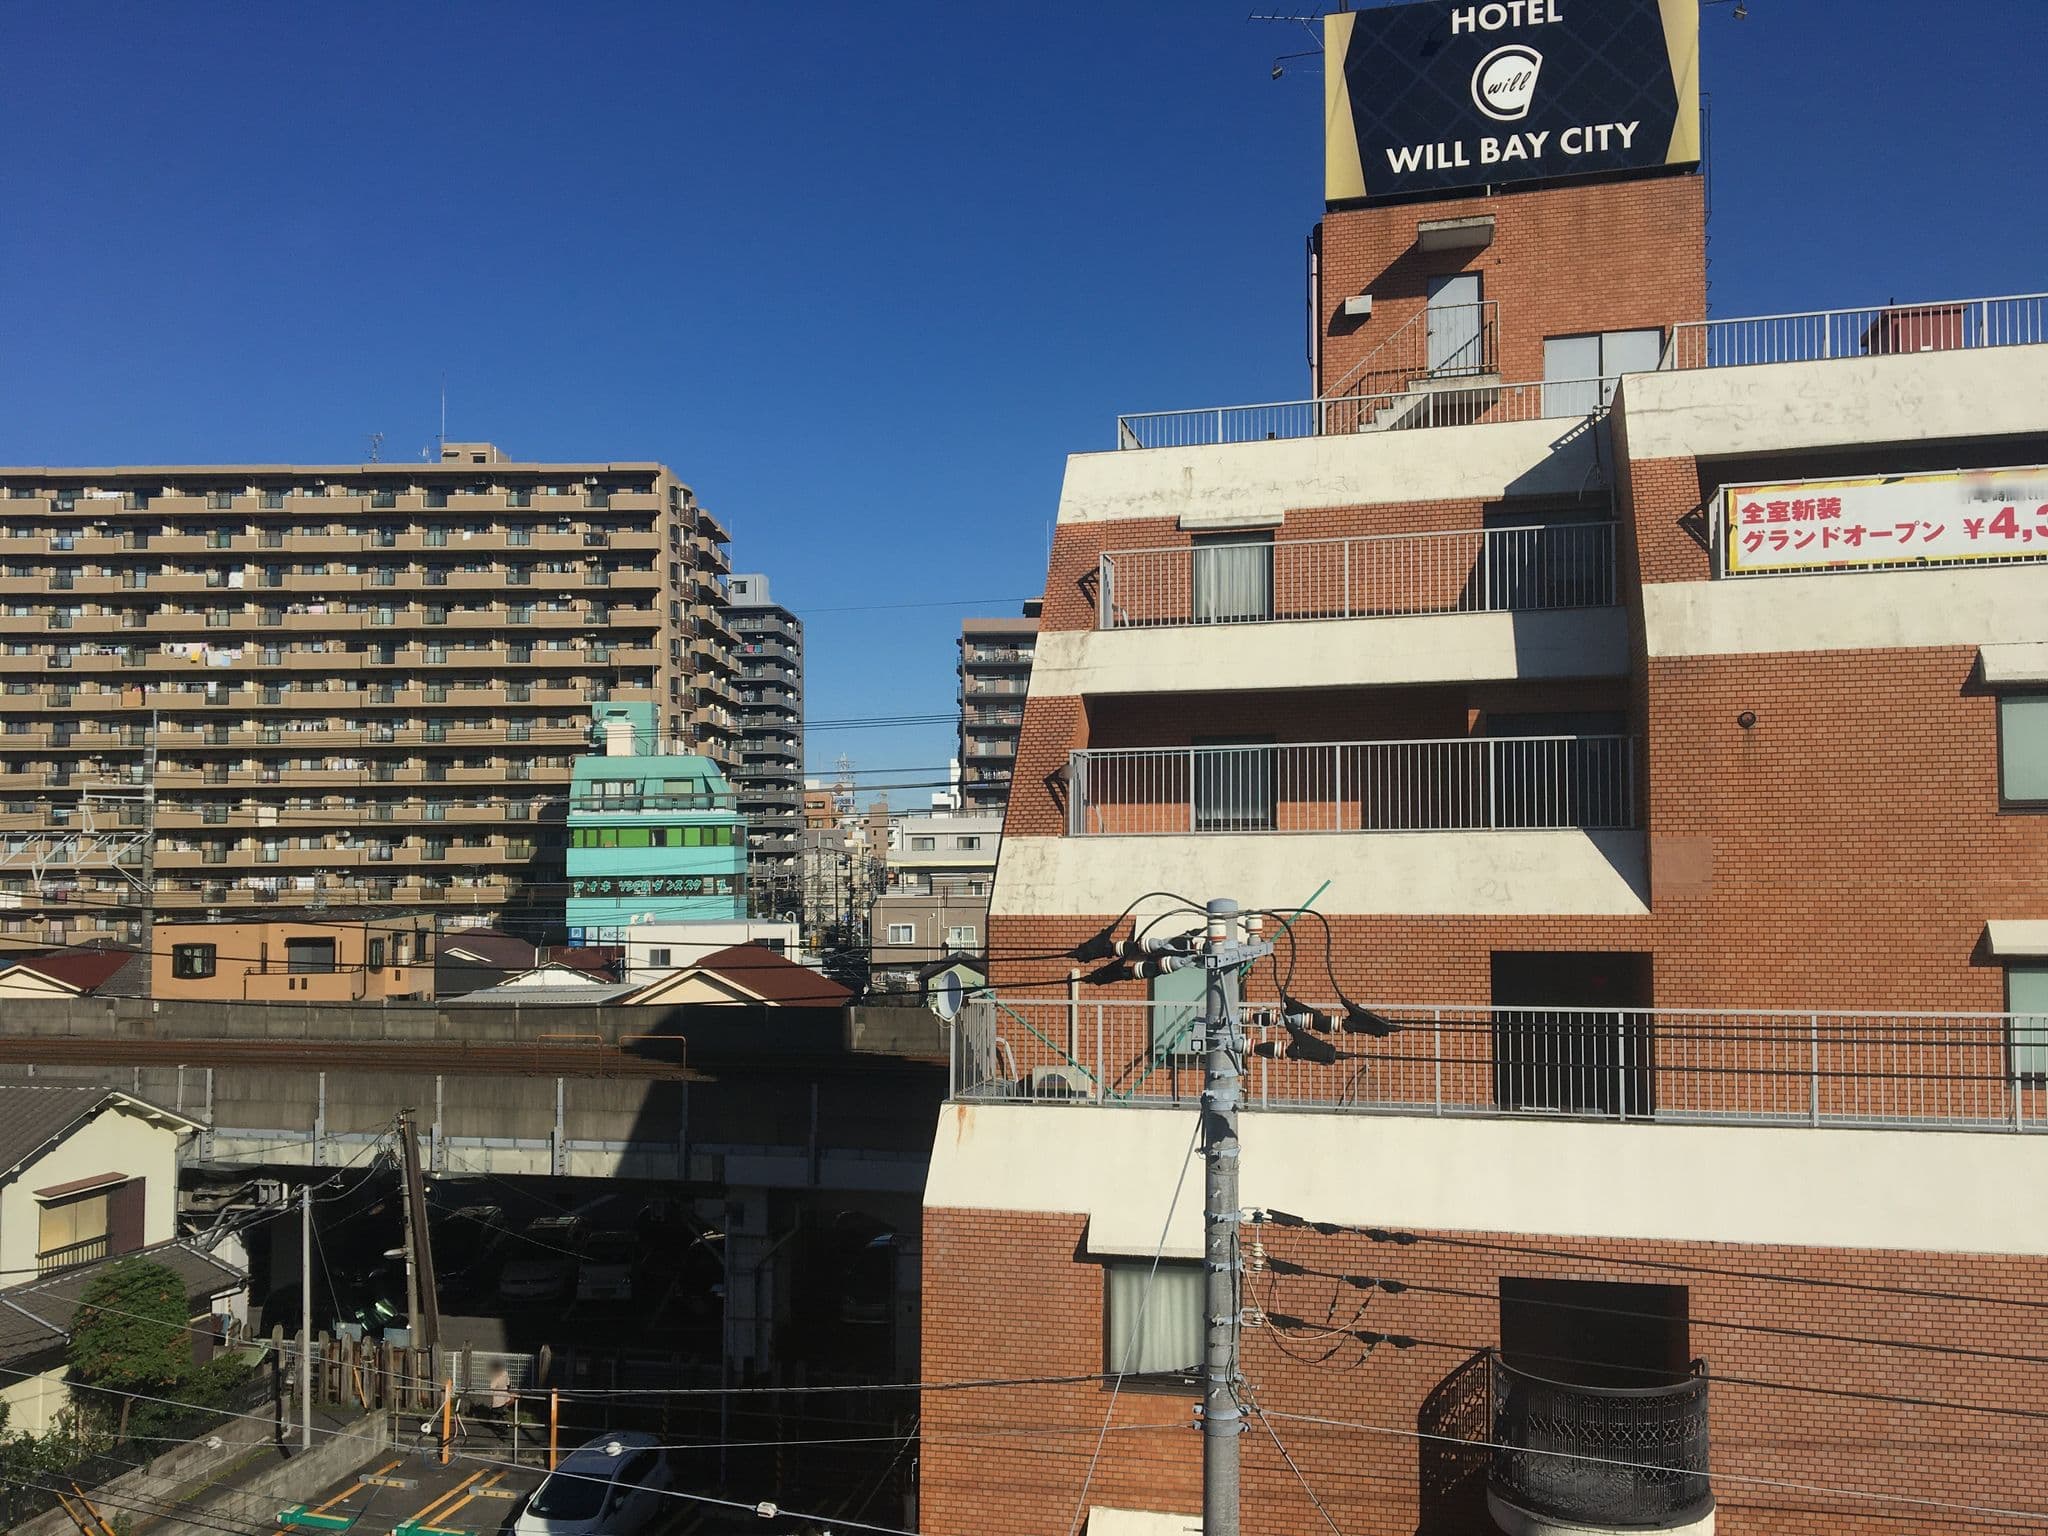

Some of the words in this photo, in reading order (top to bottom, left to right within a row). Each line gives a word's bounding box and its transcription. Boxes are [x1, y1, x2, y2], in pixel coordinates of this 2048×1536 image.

[1452, 0, 1563, 34] HOTEL
[1488, 71, 1532, 95] will
[1386, 141, 1470, 174] WILL
[1480, 131, 1550, 164] BAY
[1560, 121, 1640, 155] CITY
[1742, 497, 1842, 525] 全室新装
[1742, 520, 1946, 553] グランドオープン
